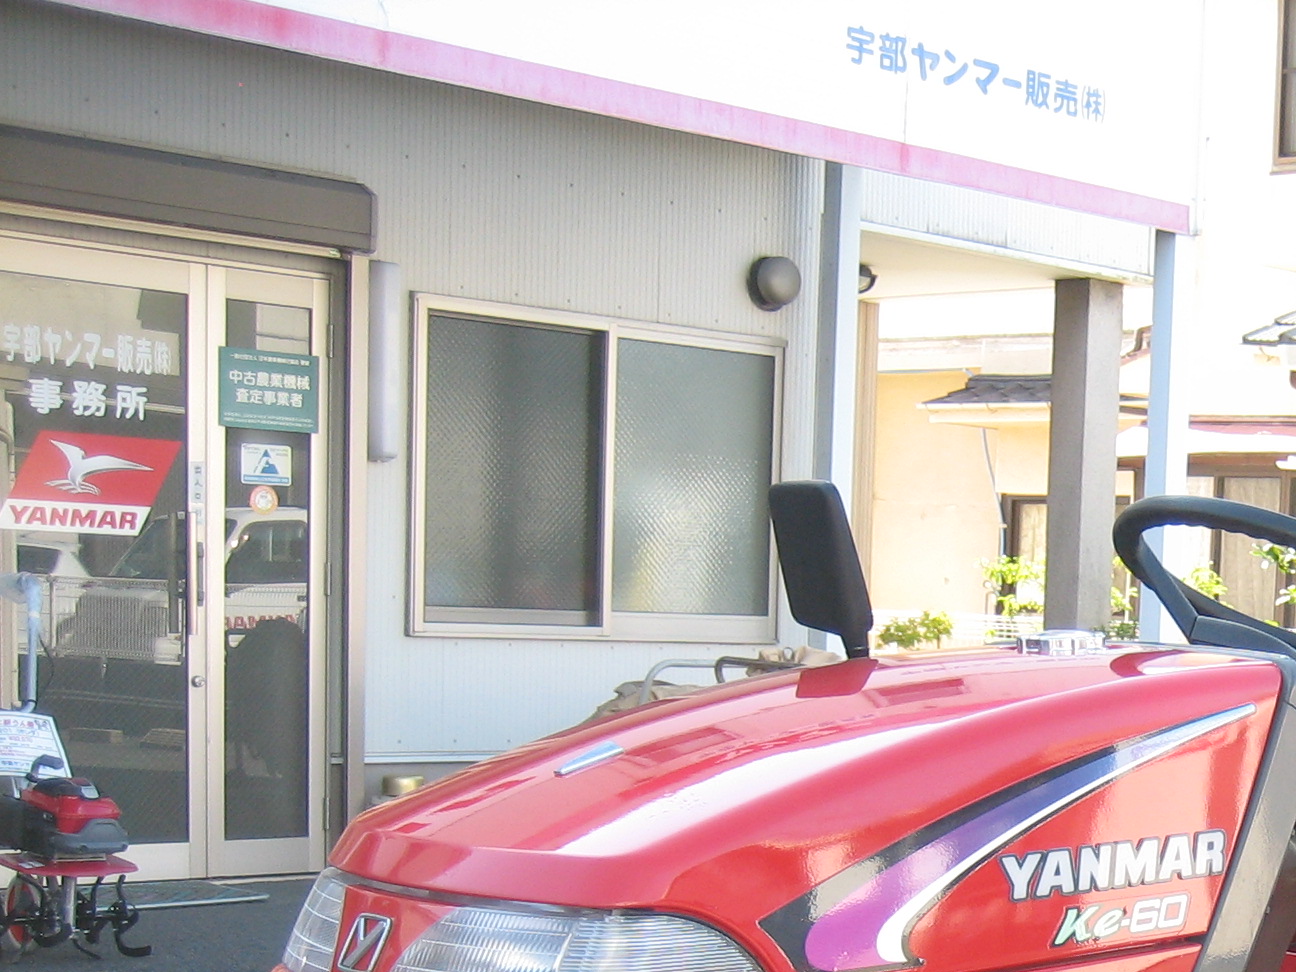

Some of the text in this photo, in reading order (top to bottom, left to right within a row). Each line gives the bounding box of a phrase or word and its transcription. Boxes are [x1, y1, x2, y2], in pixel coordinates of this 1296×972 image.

[28, 377, 148, 421] 事務所
[235, 387, 304, 408] 査定事業者
[10, 504, 138, 531] YANMAR
[1001, 828, 1227, 902] YANMAR
